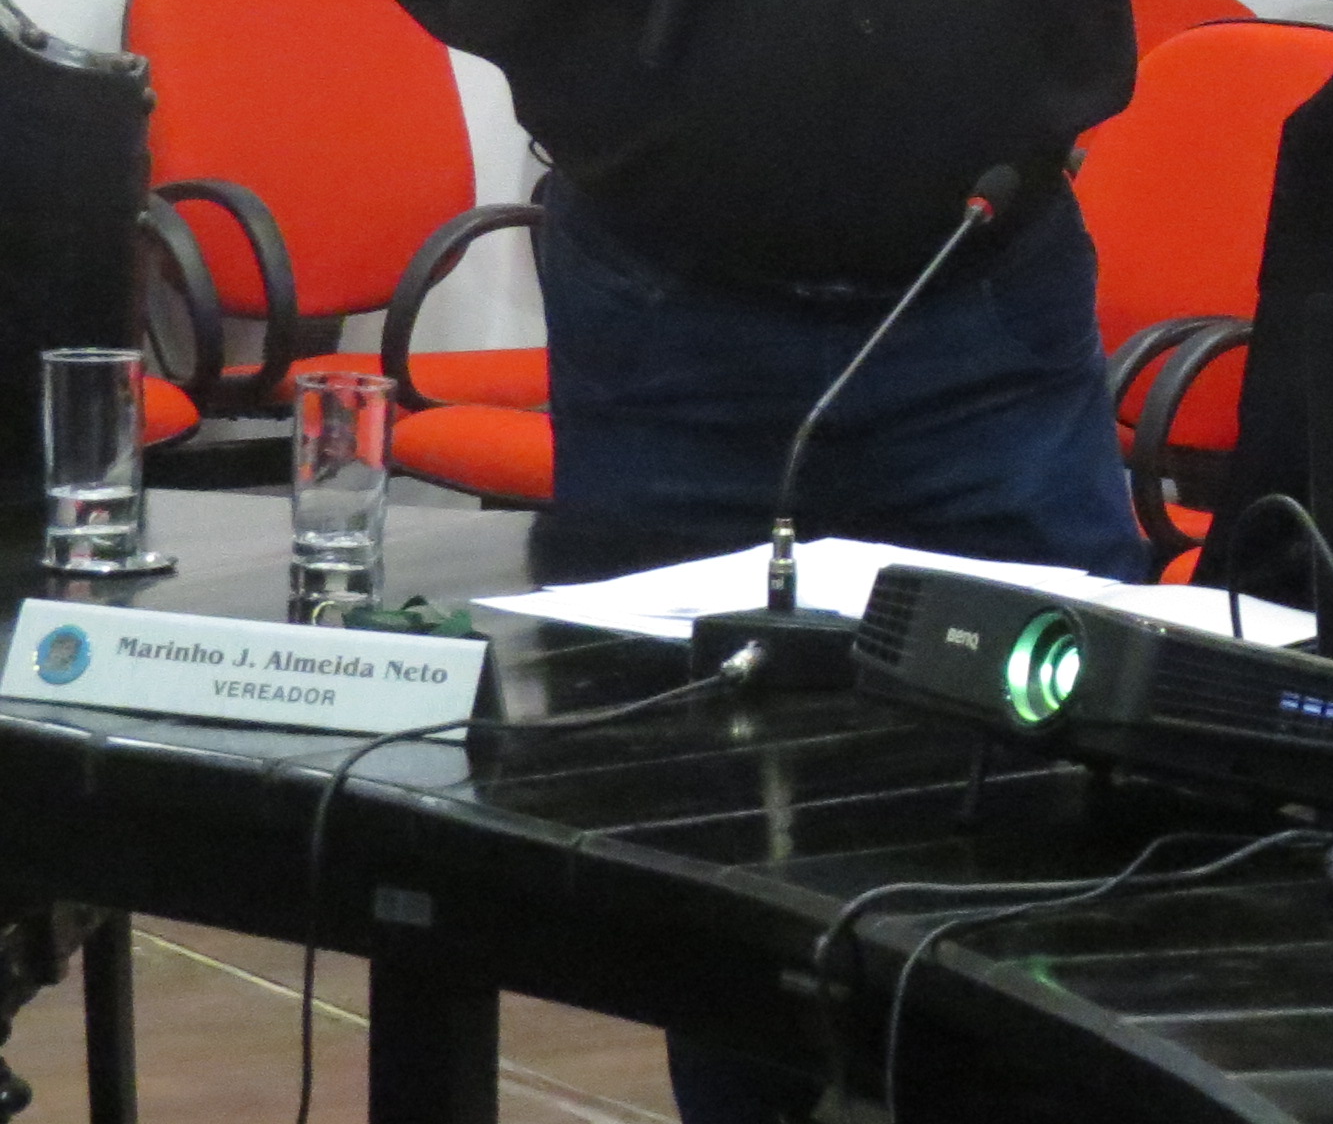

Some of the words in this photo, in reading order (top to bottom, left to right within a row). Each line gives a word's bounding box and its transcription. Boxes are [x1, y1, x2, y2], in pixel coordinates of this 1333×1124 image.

[117, 636, 224, 666] Marinho
[232, 650, 256, 670] J.
[265, 651, 374, 679] Almeida
[385, 661, 449, 685] Neto
[214, 679, 337, 707] VEREADOR
